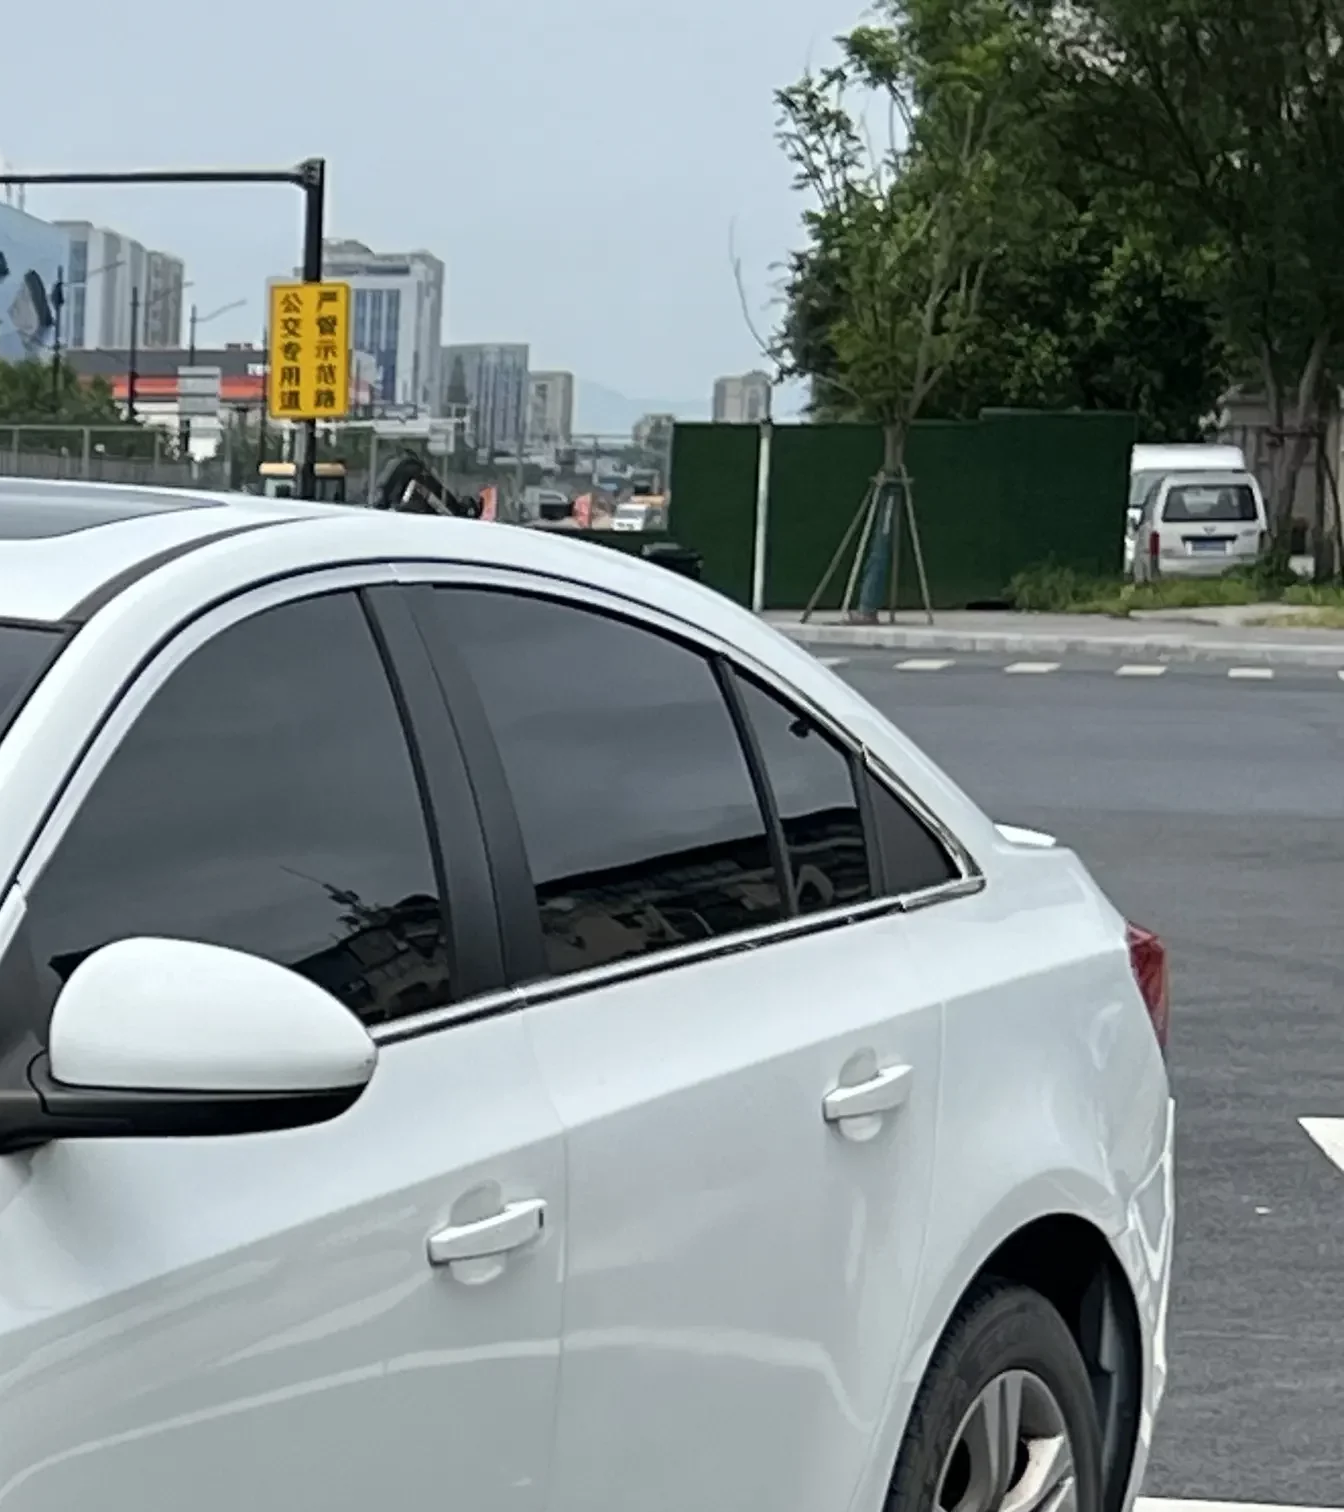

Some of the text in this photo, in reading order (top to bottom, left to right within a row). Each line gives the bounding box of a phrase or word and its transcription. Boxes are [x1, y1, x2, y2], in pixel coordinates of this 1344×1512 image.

[278, 292, 304, 411] 公交专用道
[313, 290, 339, 409] 严管示范路
